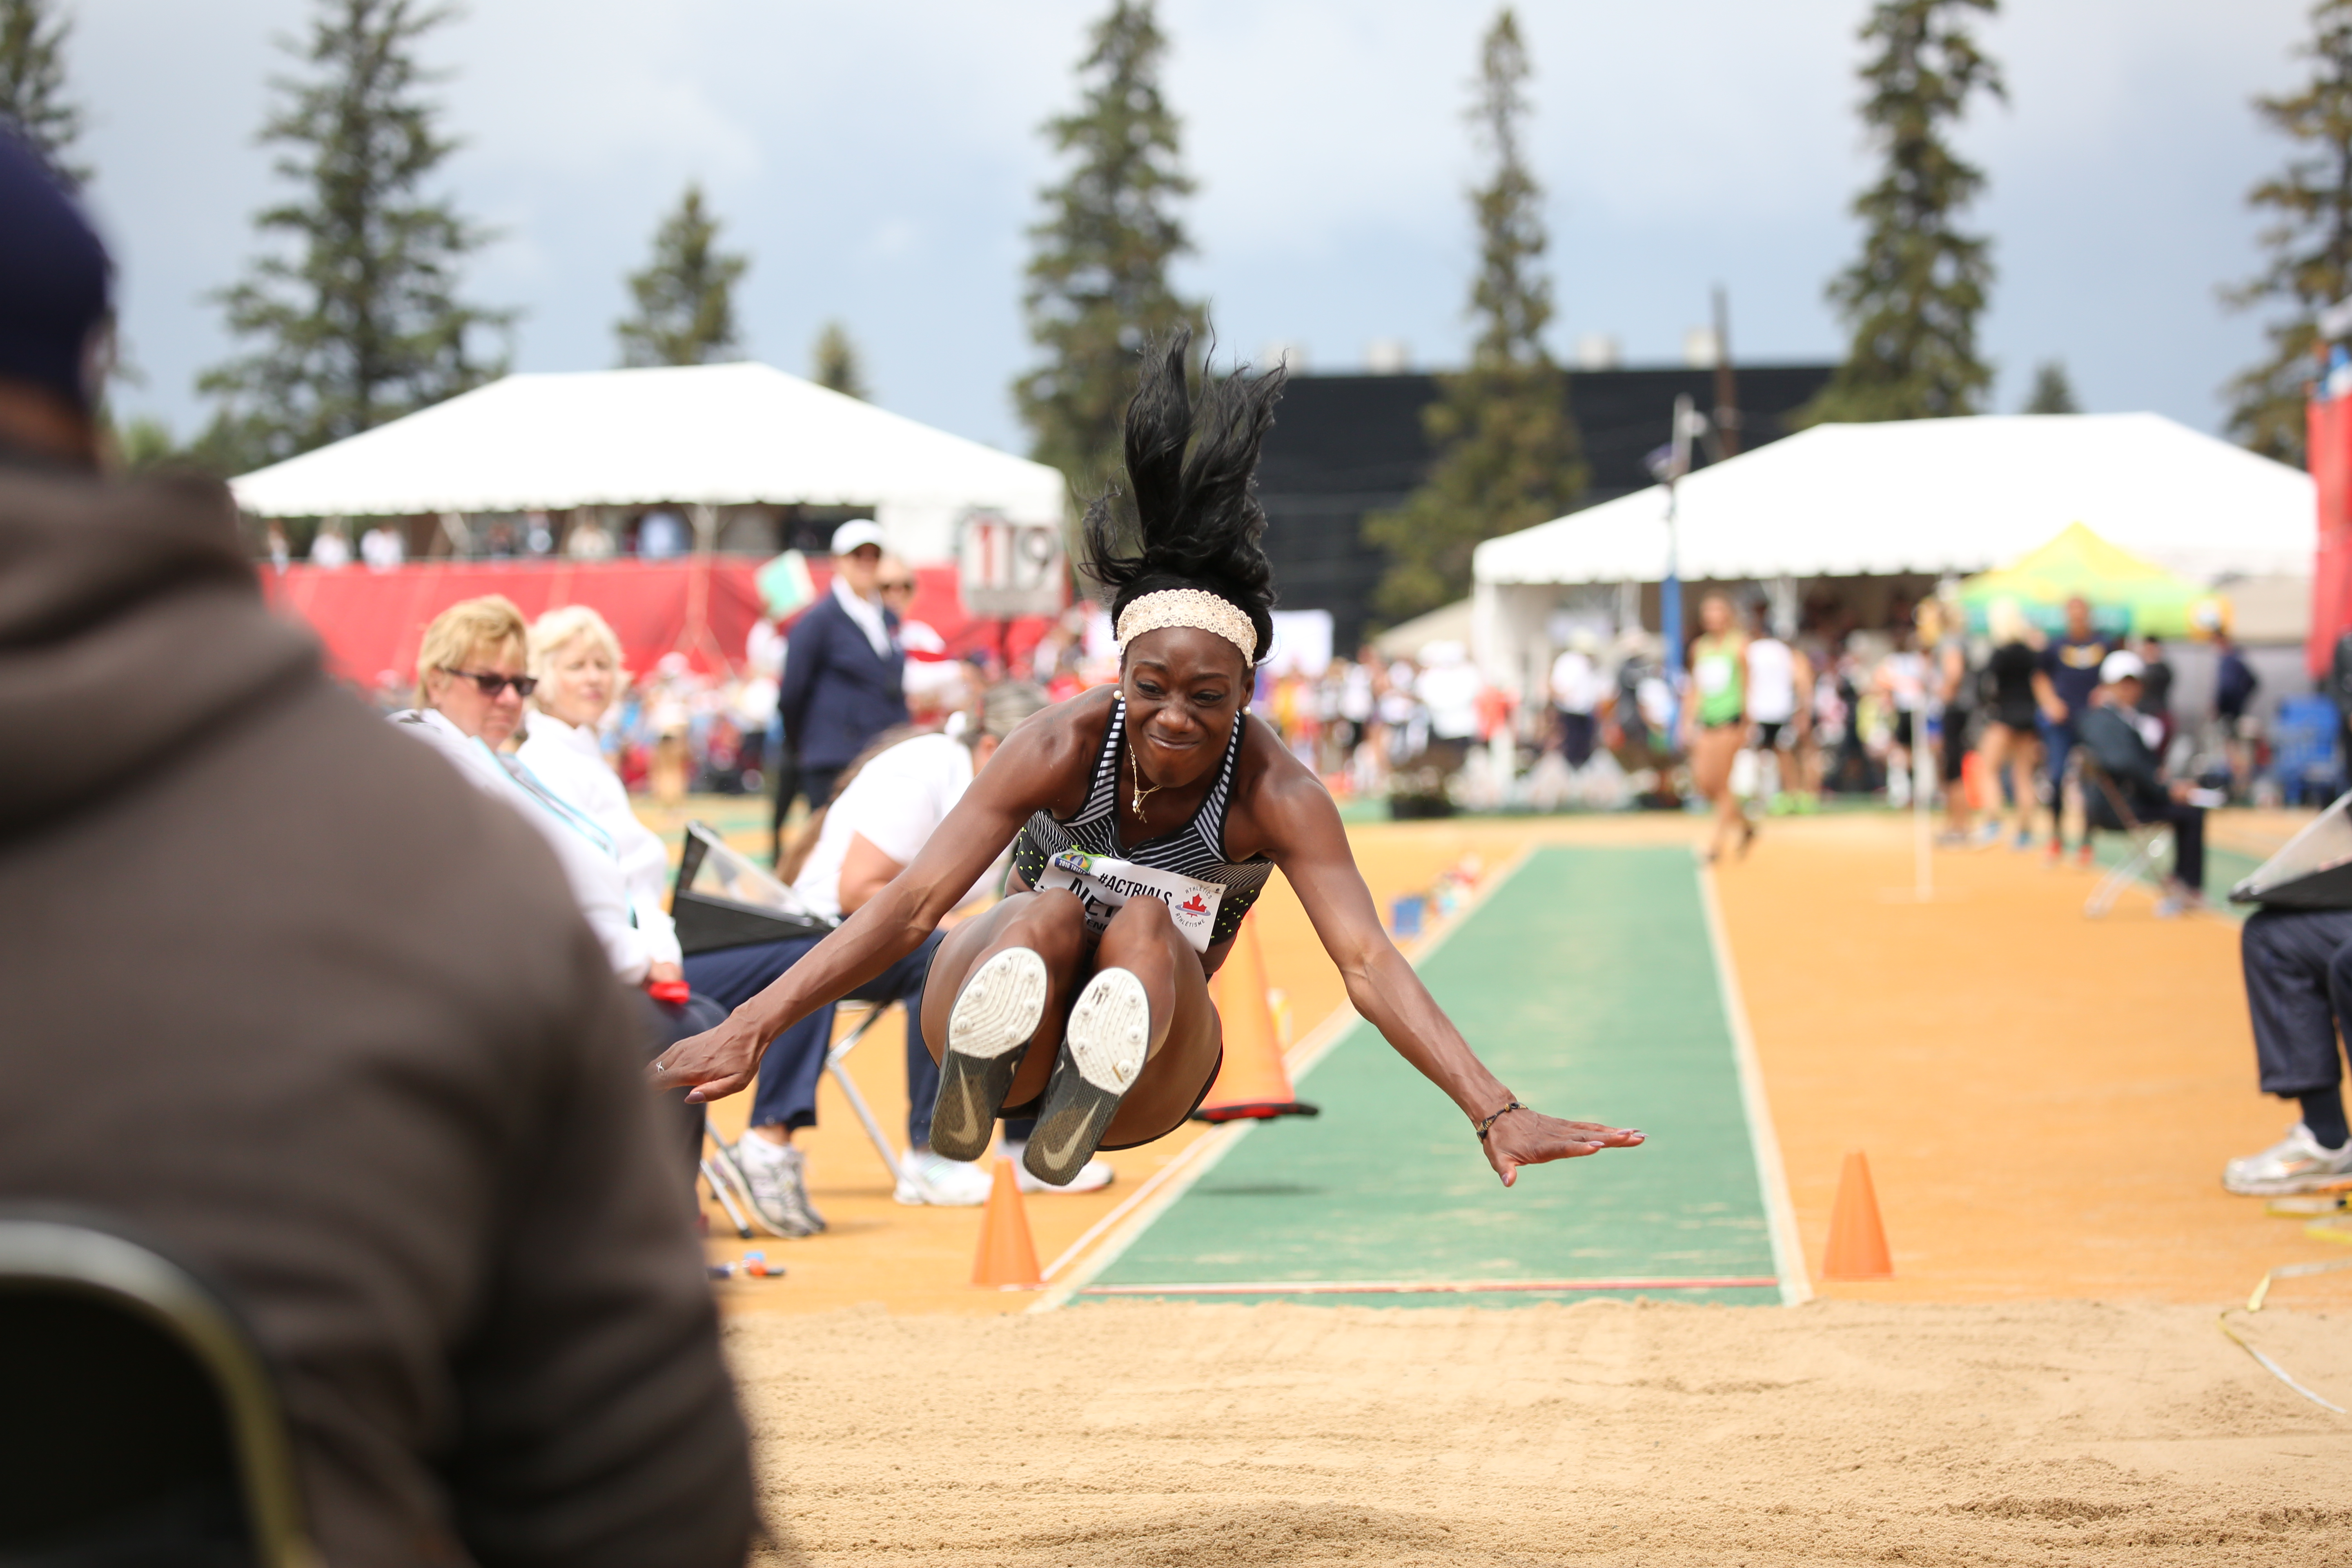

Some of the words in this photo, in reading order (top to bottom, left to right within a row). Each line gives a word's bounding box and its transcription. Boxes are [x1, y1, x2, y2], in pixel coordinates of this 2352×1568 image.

[1059, 860, 1070, 869] 2016
[1071, 864, 1086, 875] TRIALS
[1185, 886, 1212, 900] ATHLETICS
